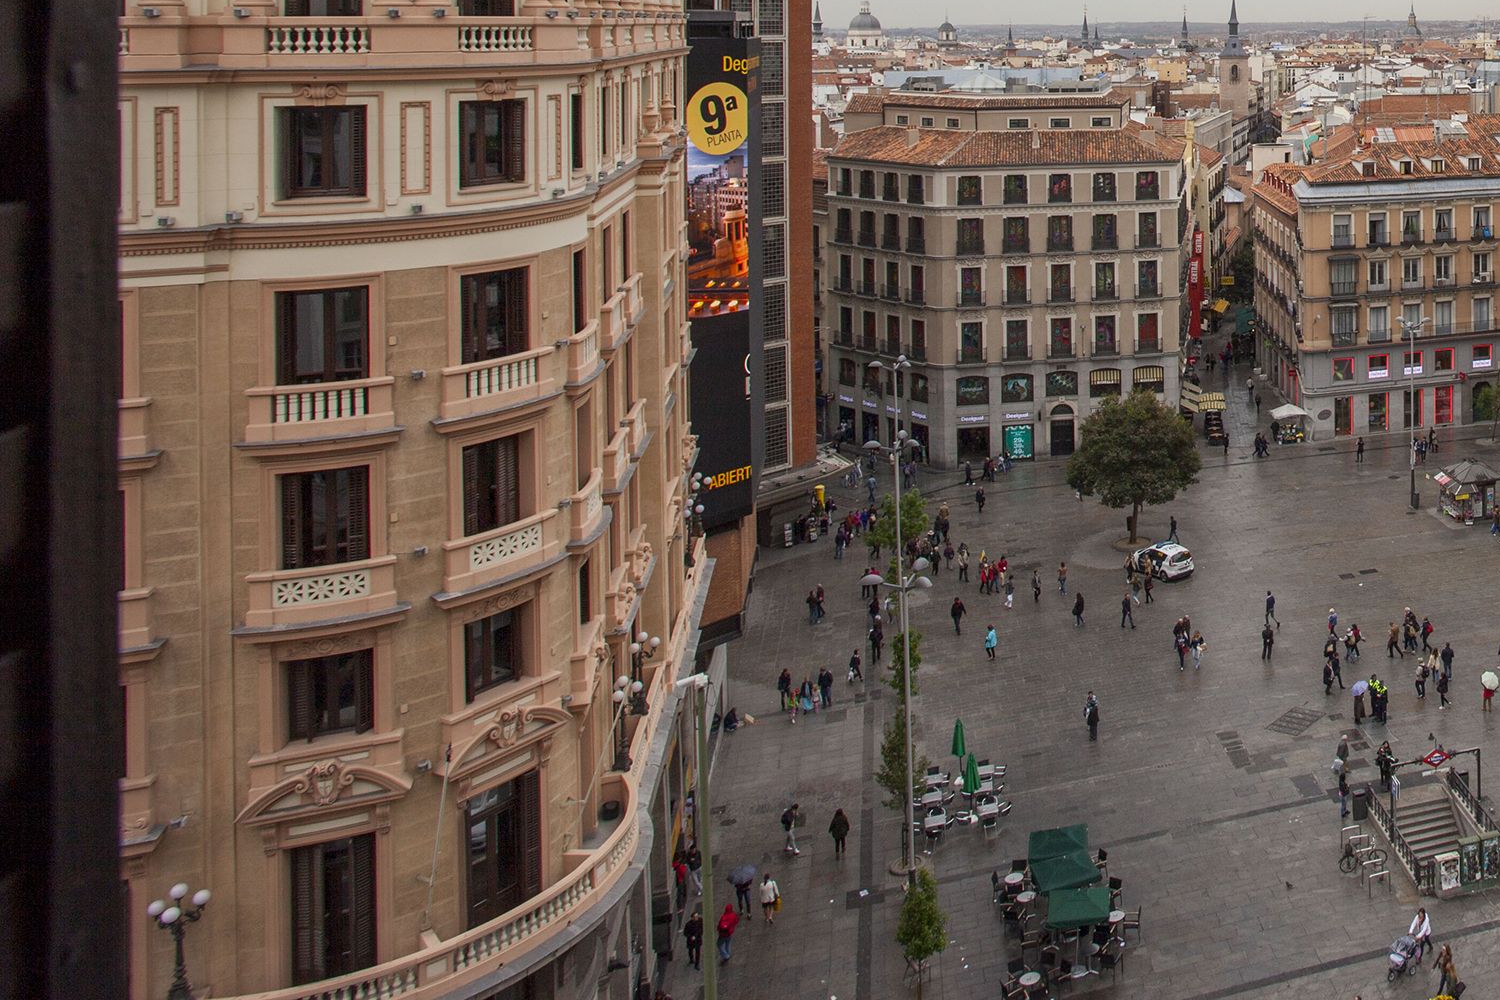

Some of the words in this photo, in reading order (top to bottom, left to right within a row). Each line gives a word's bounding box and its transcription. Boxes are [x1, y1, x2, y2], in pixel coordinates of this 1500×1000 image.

[706, 129, 742, 148] PLANTA
[1190, 260, 1198, 284] CENTRAL
[960, 414, 985, 422] Desigual
[1005, 411, 1029, 420] Desigual
[708, 465, 752, 490] ABIERT
